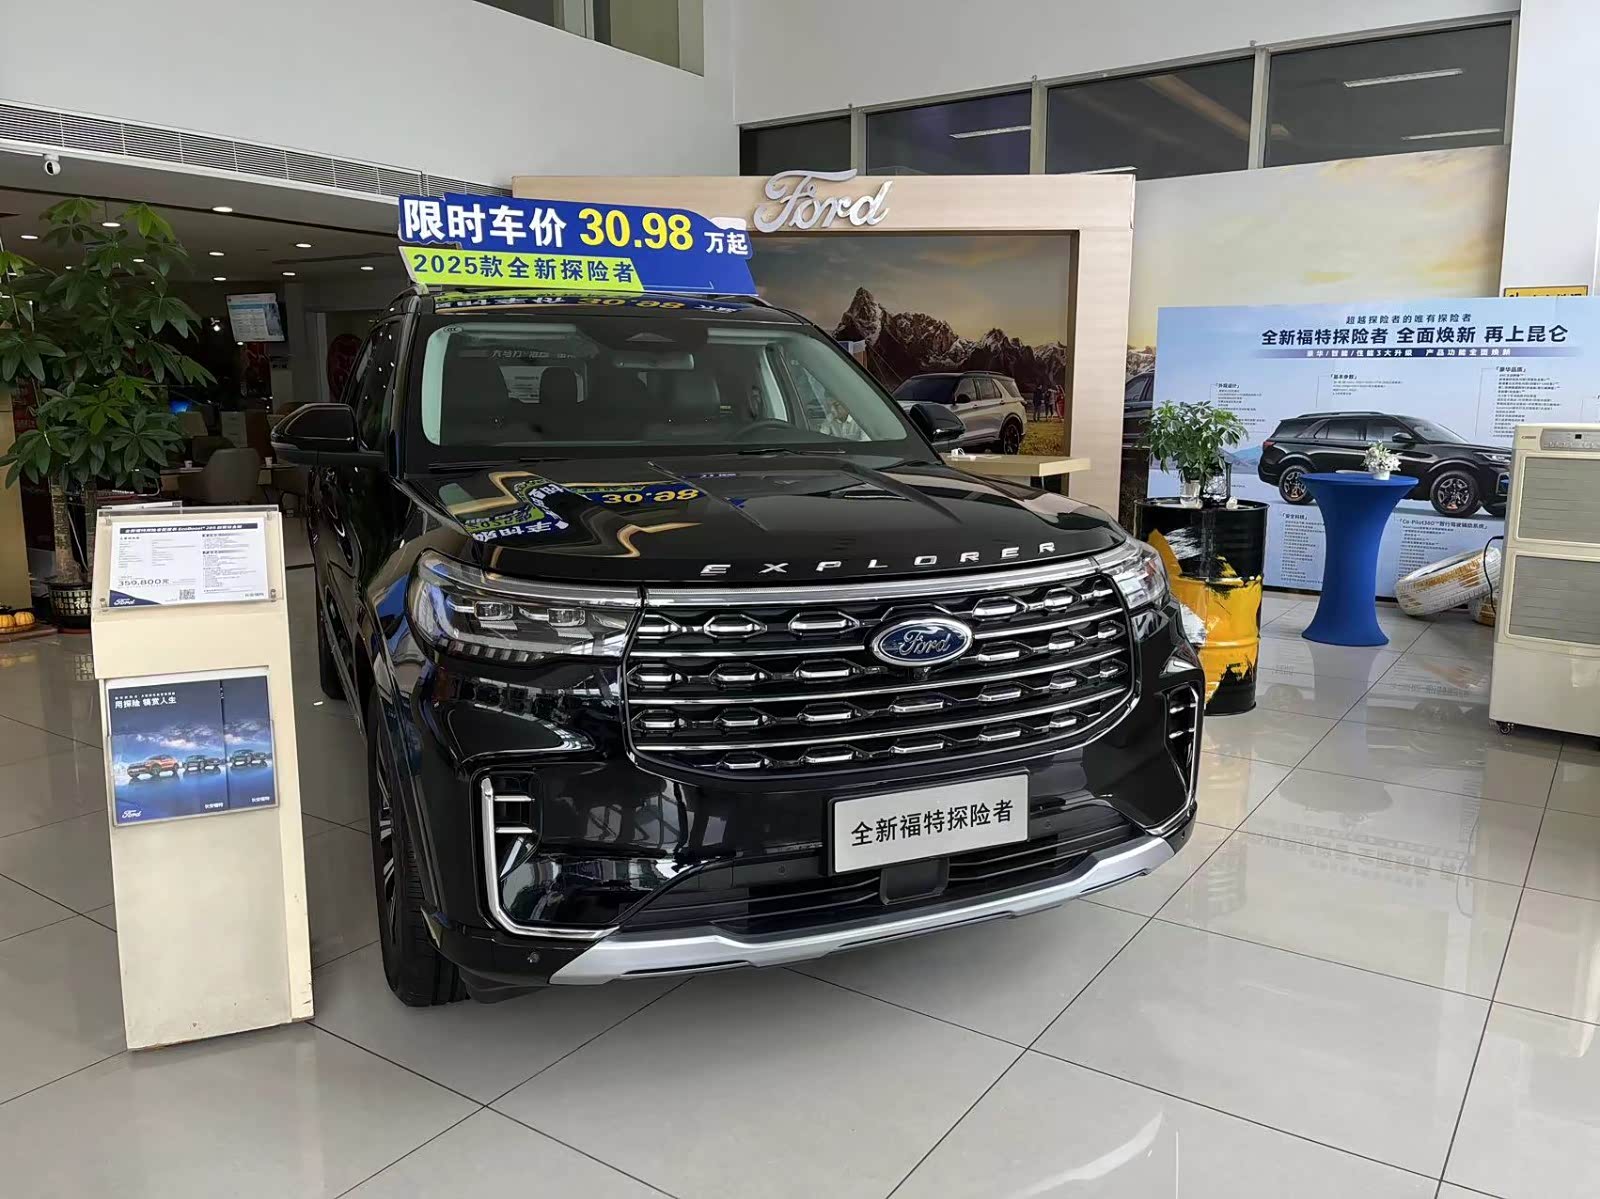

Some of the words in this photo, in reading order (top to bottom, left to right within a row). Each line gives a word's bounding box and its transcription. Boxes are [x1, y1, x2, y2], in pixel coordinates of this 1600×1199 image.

[753, 169, 893, 233] Ford
[404, 198, 567, 248] 限时车价
[578, 207, 693, 251] 30.98
[705, 229, 749, 256] 万起
[413, 252, 635, 283] 2025款全新探险者
[1345, 313, 1472, 325] 超越探险者的唯有探险者
[1261, 328, 1389, 346] 全新福特探险者
[1396, 326, 1476, 345] 全面焕新
[1484, 324, 1569, 343] 再上昆仑
[701, 542, 1056, 576] EXPLORER
[898, 627, 950, 655] Ford
[122, 809, 142, 819] Ford
[850, 799, 1014, 847] 全新福特探险者
